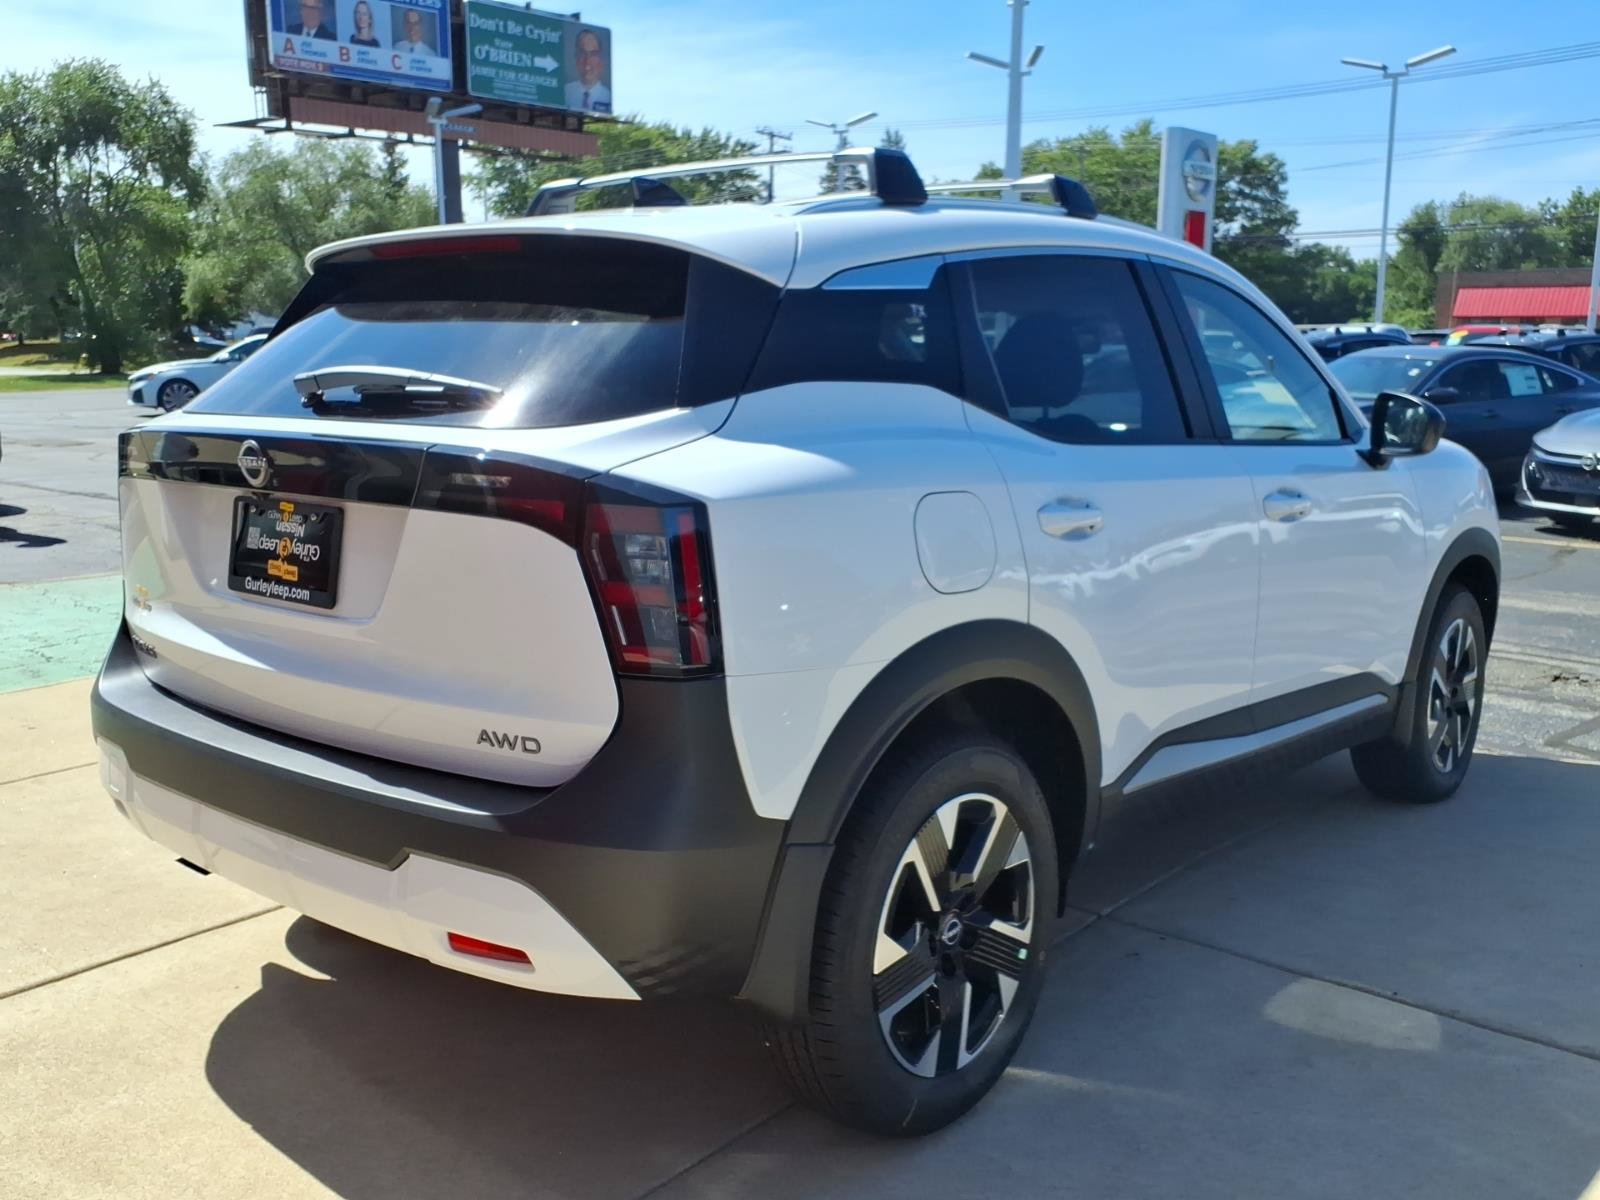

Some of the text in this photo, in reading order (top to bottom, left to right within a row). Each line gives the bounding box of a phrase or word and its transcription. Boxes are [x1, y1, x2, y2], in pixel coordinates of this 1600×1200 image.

[470, 12, 504, 32] Don't
[507, 20, 523, 36] Be
[283, 37, 296, 55] A
[339, 46, 350, 62] B
[474, 44, 532, 67] O'BRIEN
[392, 54, 402, 71] C
[276, 521, 305, 537] Nissan
[258, 534, 320, 561] Gurley Leep
[245, 576, 310, 601] Gurleyleep.com
[476, 729, 541, 754] AWD
